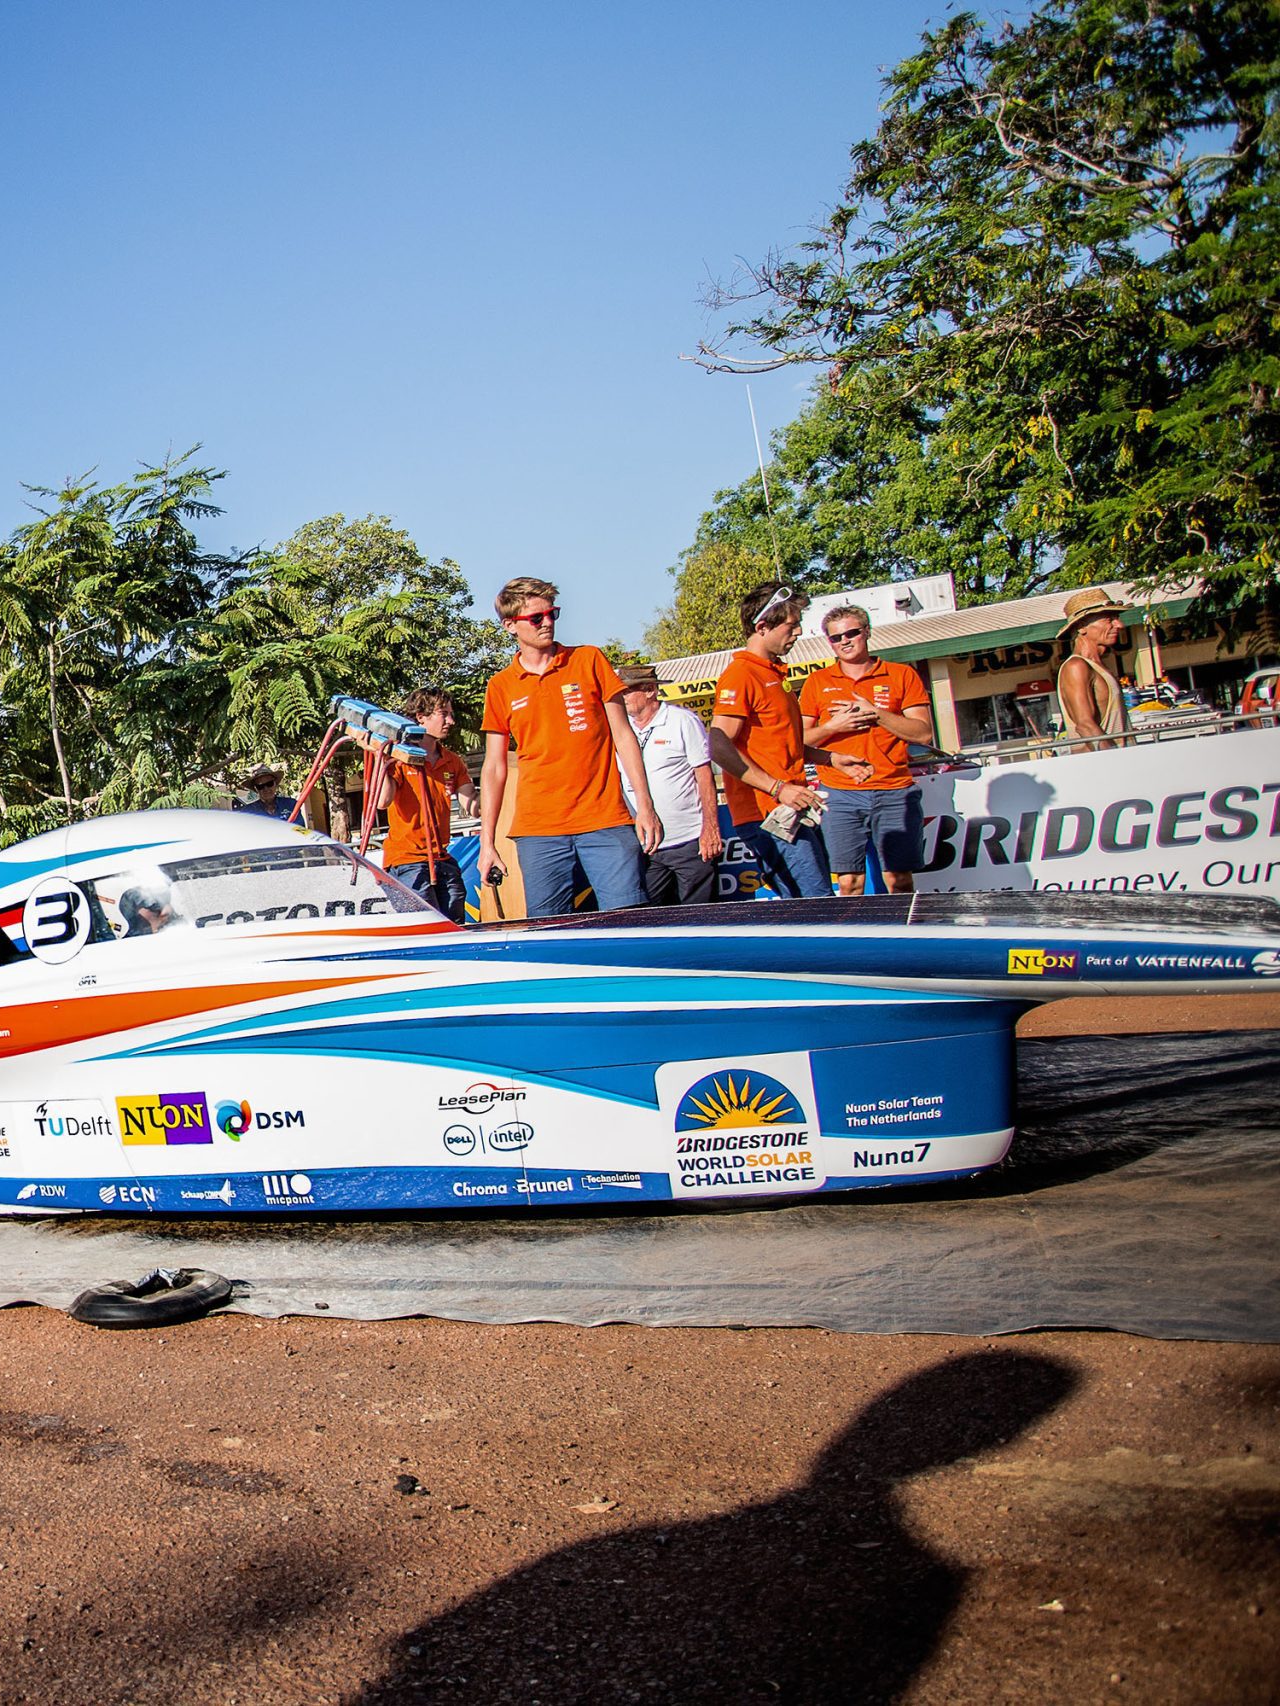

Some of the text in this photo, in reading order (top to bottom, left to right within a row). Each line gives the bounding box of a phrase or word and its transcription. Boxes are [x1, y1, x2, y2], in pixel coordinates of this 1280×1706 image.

[683, 699, 705, 709] COLD
[31, 891, 81, 949] 3
[1012, 955, 1246, 969] NUON Part of VATTENFALL
[438, 1091, 527, 1106] LeasePlan
[845, 1095, 944, 1114] Nuon Solar Team
[120, 1103, 204, 1136] NUON
[255, 1110, 305, 1130] DSM
[846, 1108, 942, 1127] The Netherlands
[447, 1128, 528, 1144] DELL intel
[676, 1131, 809, 1154] BRIDGESTONE
[853, 1142, 931, 1168] Nuna7
[514, 1177, 574, 1193] Brunel
[585, 1173, 641, 1184] Technolution
[680, 1167, 816, 1187] CHALLENGE
[39, 1185, 66, 1197] RDW
[119, 1186, 156, 1202] ECN
[452, 1182, 508, 1196] Chroma
[266, 1195, 315, 1207] micpoint
